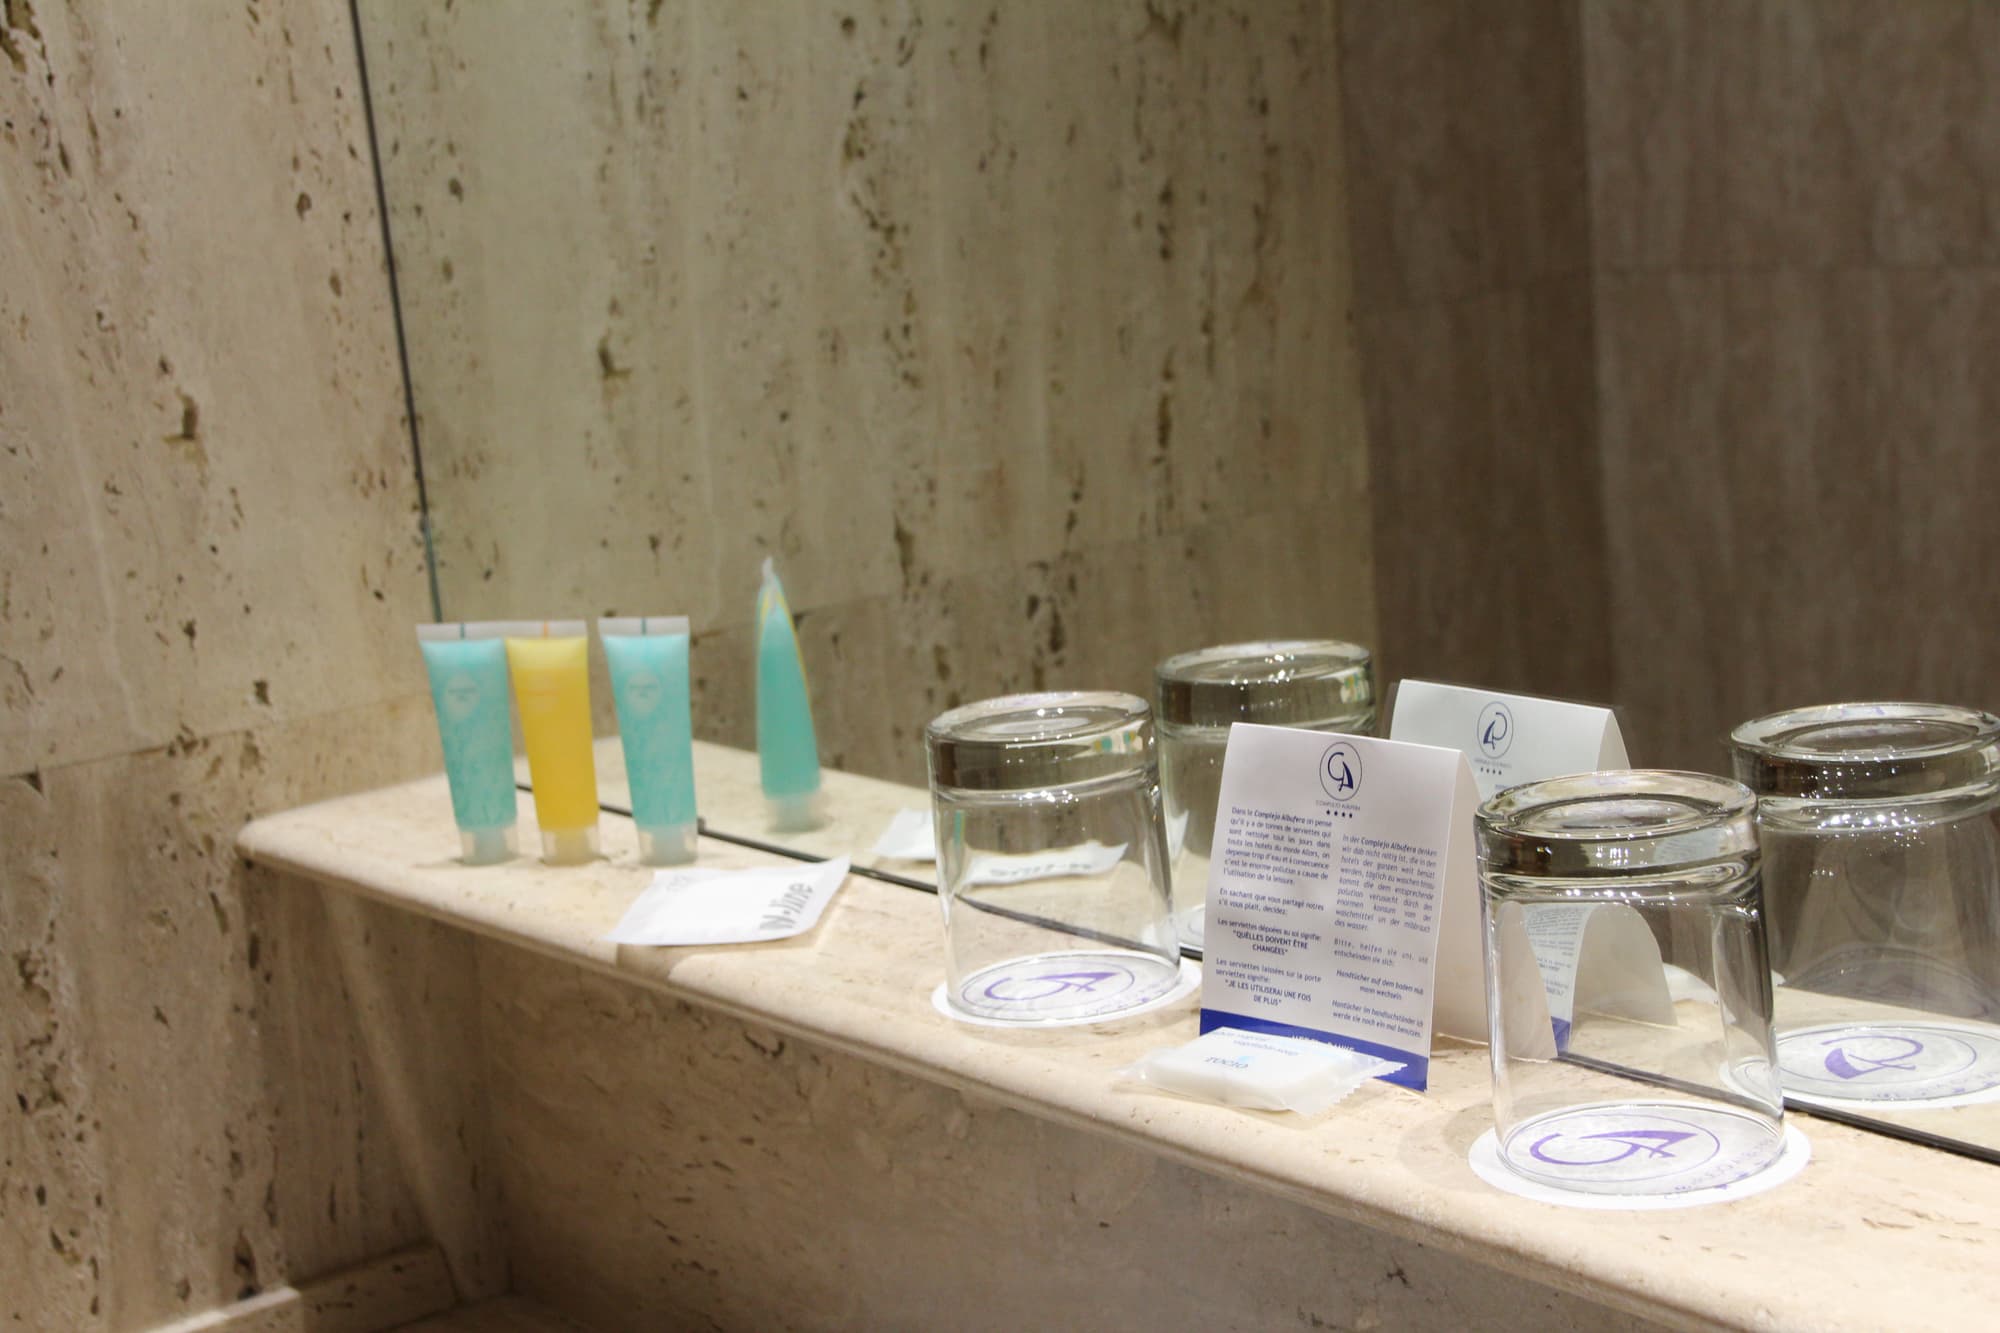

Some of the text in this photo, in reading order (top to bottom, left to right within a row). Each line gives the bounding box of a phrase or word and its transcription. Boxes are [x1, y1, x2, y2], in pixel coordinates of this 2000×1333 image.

[1232, 807, 1245, 815] Dans
[1255, 810, 1280, 820] Complejo
[1282, 814, 1305, 823] Albufera
[1265, 823, 1283, 831] tonnes
[1293, 826, 1320, 836] serviettes
[1317, 840, 1330, 848] dans
[1361, 837, 1389, 849] Complejo
[1391, 842, 1416, 853] Albufera
[1283, 846, 1300, 854] monde
[1366, 849, 1380, 858] nicht
[1225, 858, 1239, 866] c'est
[1342, 856, 1359, 864] hotels
[1340, 868, 1364, 878] werden,
[1339, 877, 1359, 886] kommt
[1230, 889, 1252, 898] sachant
[1306, 903, 1324, 911] notres
[1404, 899, 1419, 908] durch
[1337, 899, 1363, 908] enormen
[1374, 904, 1396, 914] konsum
[1336, 909, 1374, 921] waschmittel
[1229, 919, 1257, 930] serviettes
[1265, 936, 1291, 946] DOIVENT
[1293, 938, 1308, 949] ÊTRE
[1216, 969, 1246, 979] serviettes
[1229, 961, 1260, 971] serviettes
[1305, 973, 1321, 982] porte
[1396, 982, 1413, 992] boden
[1251, 984, 1283, 996] UTILISERAI
[1298, 993, 1311, 1002] FOIS
[1333, 1012, 1351, 1020] werde
[1362, 1018, 1375, 1026] noch
